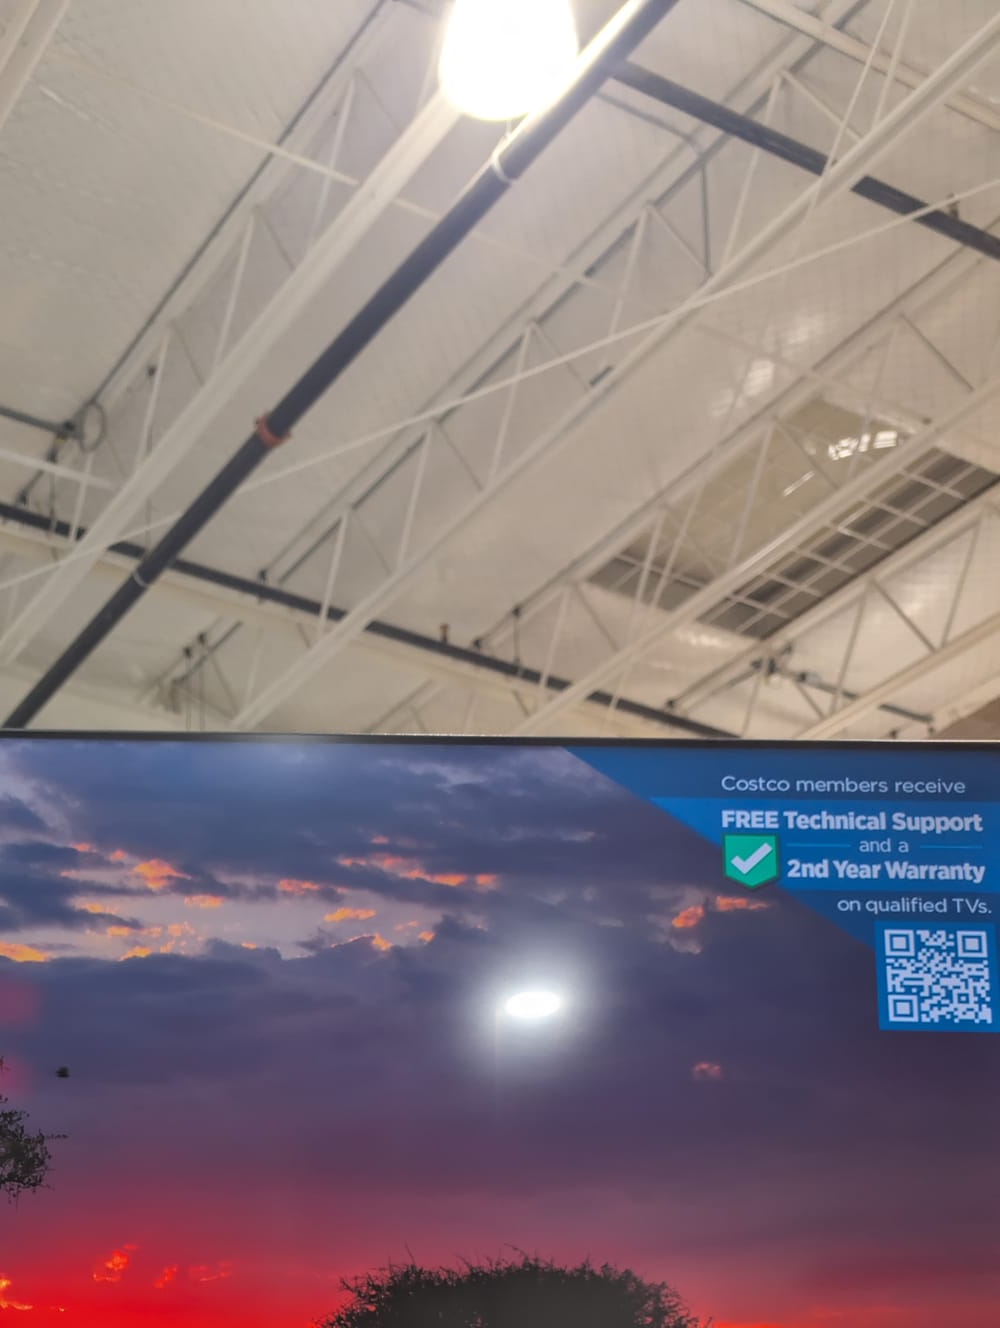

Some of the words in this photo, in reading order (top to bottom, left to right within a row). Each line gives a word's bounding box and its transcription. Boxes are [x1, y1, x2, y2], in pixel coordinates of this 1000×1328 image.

[721, 775, 790, 792] Costco
[796, 777, 888, 793] members
[894, 778, 966, 794] receive
[721, 810, 779, 828] FREE
[784, 811, 887, 830] Technical
[892, 812, 983, 834] Support
[859, 838, 891, 852] and
[898, 840, 909, 853] a
[787, 859, 829, 878] 2nd
[833, 860, 881, 879] Year
[885, 861, 986, 884] Warranty
[837, 900, 861, 913] on
[865, 897, 948, 914] qualified
[951, 899, 993, 914] TVs.
